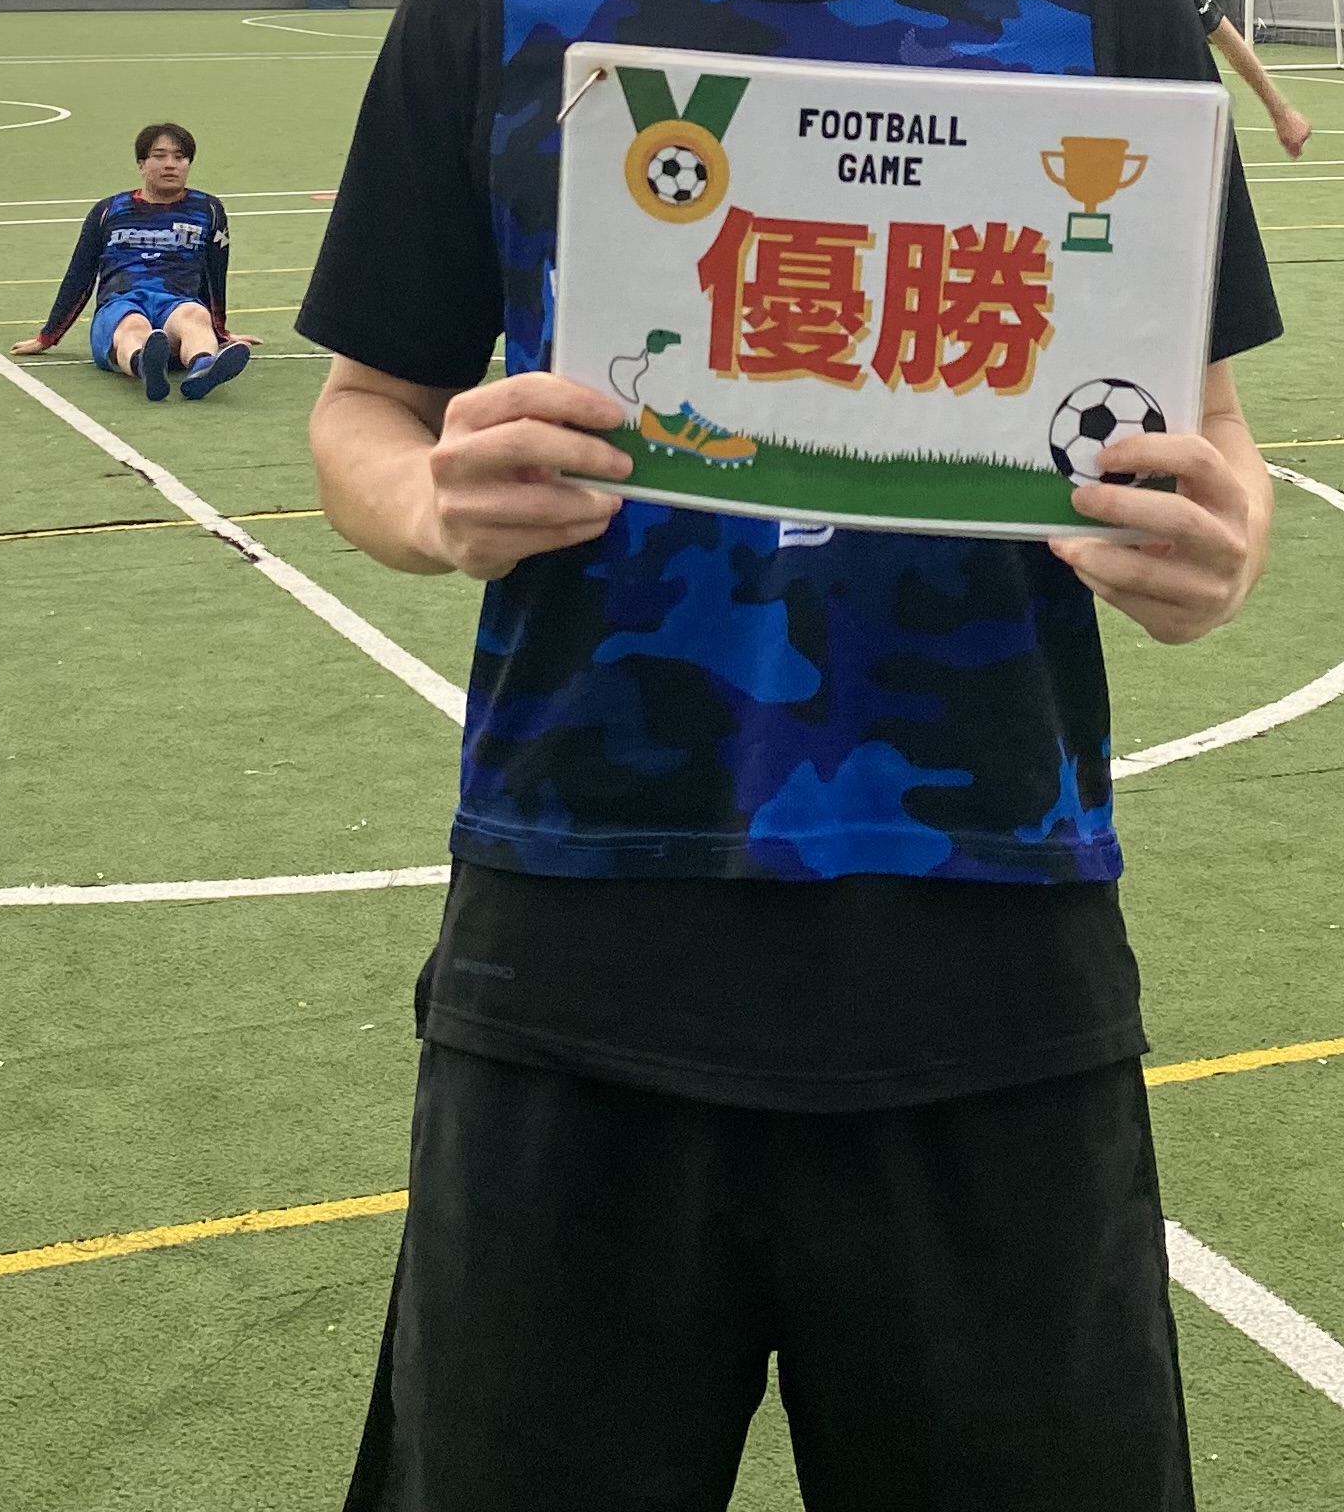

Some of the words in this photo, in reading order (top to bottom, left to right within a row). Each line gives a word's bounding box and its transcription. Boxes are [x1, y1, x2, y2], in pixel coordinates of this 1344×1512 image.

[798, 107, 967, 147] FOOTBALL
[838, 153, 923, 187] GAME
[697, 206, 1055, 396] 優勝
